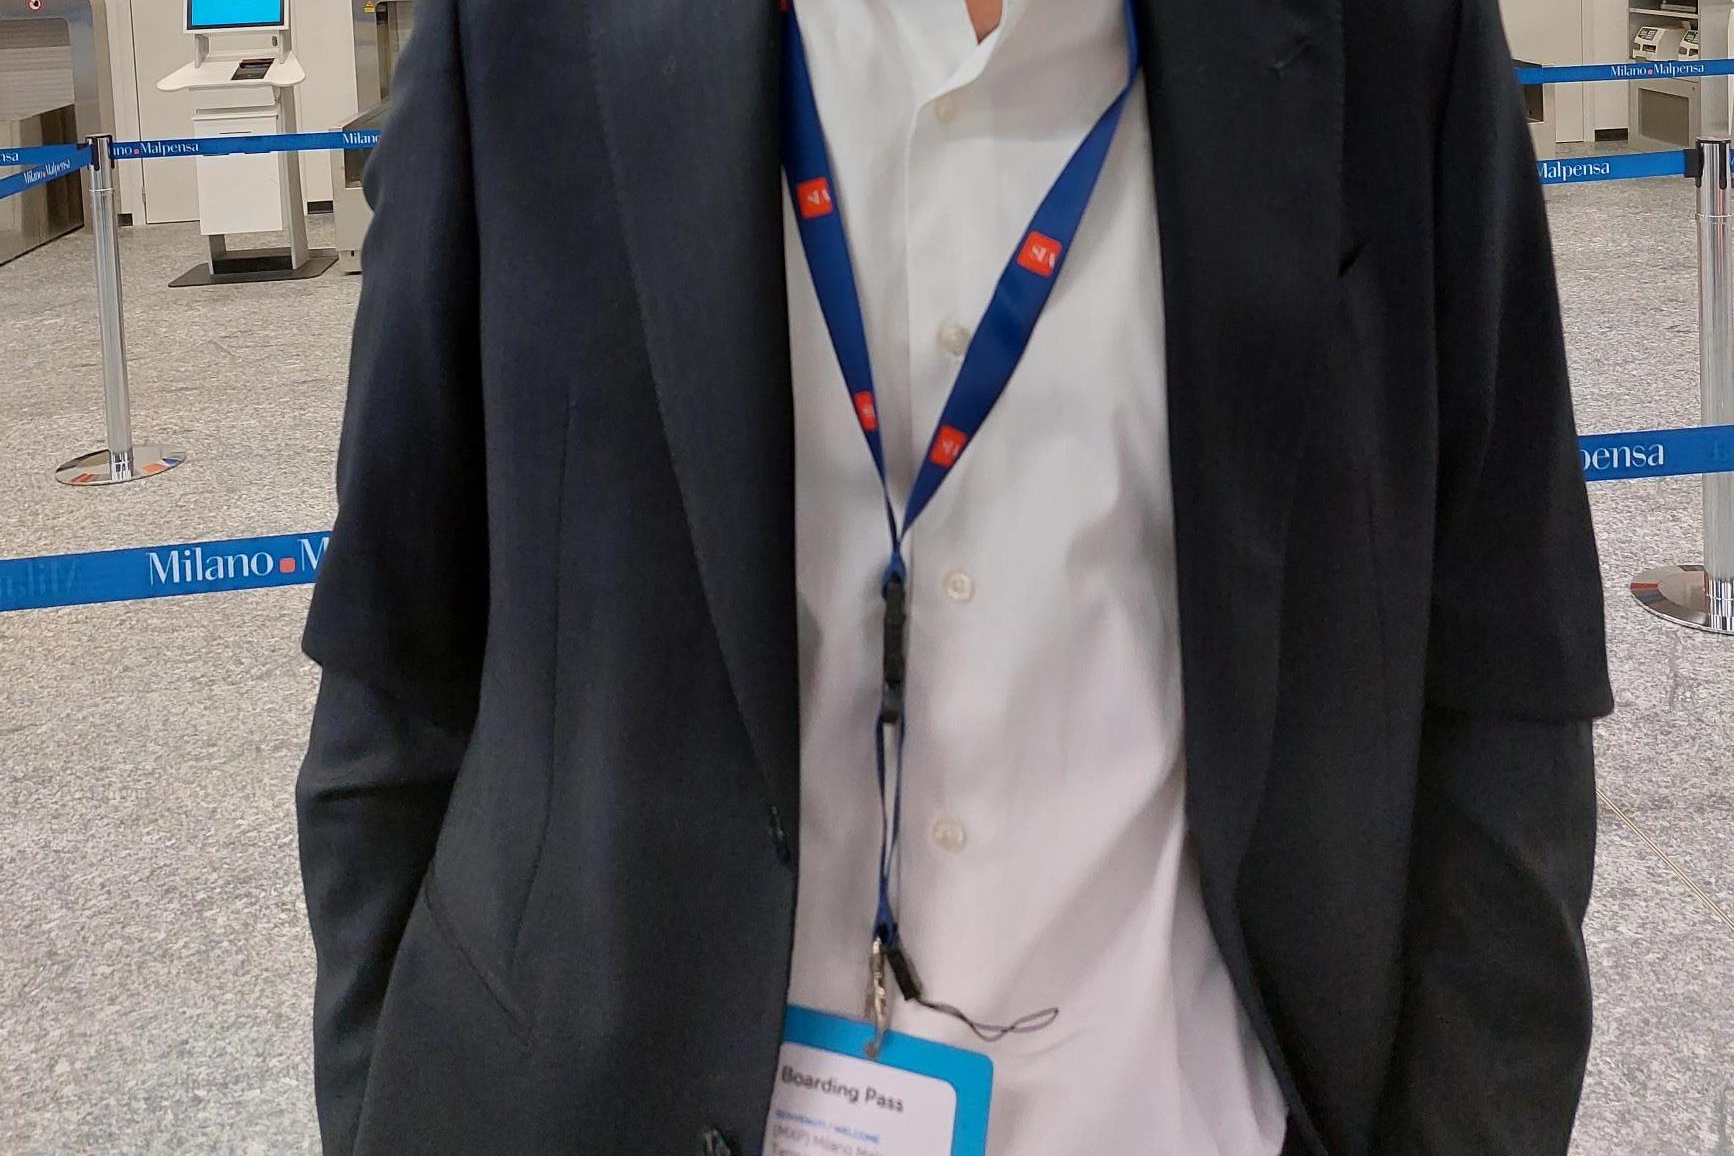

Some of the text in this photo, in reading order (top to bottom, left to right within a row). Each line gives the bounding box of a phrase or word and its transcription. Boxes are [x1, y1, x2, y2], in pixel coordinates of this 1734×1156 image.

[1611, 62, 1705, 77] Milano Malpensa
[140, 141, 199, 156] Malpensa
[146, 546, 274, 587] Milano
[780, 1065, 904, 1113] Boarding Pass
